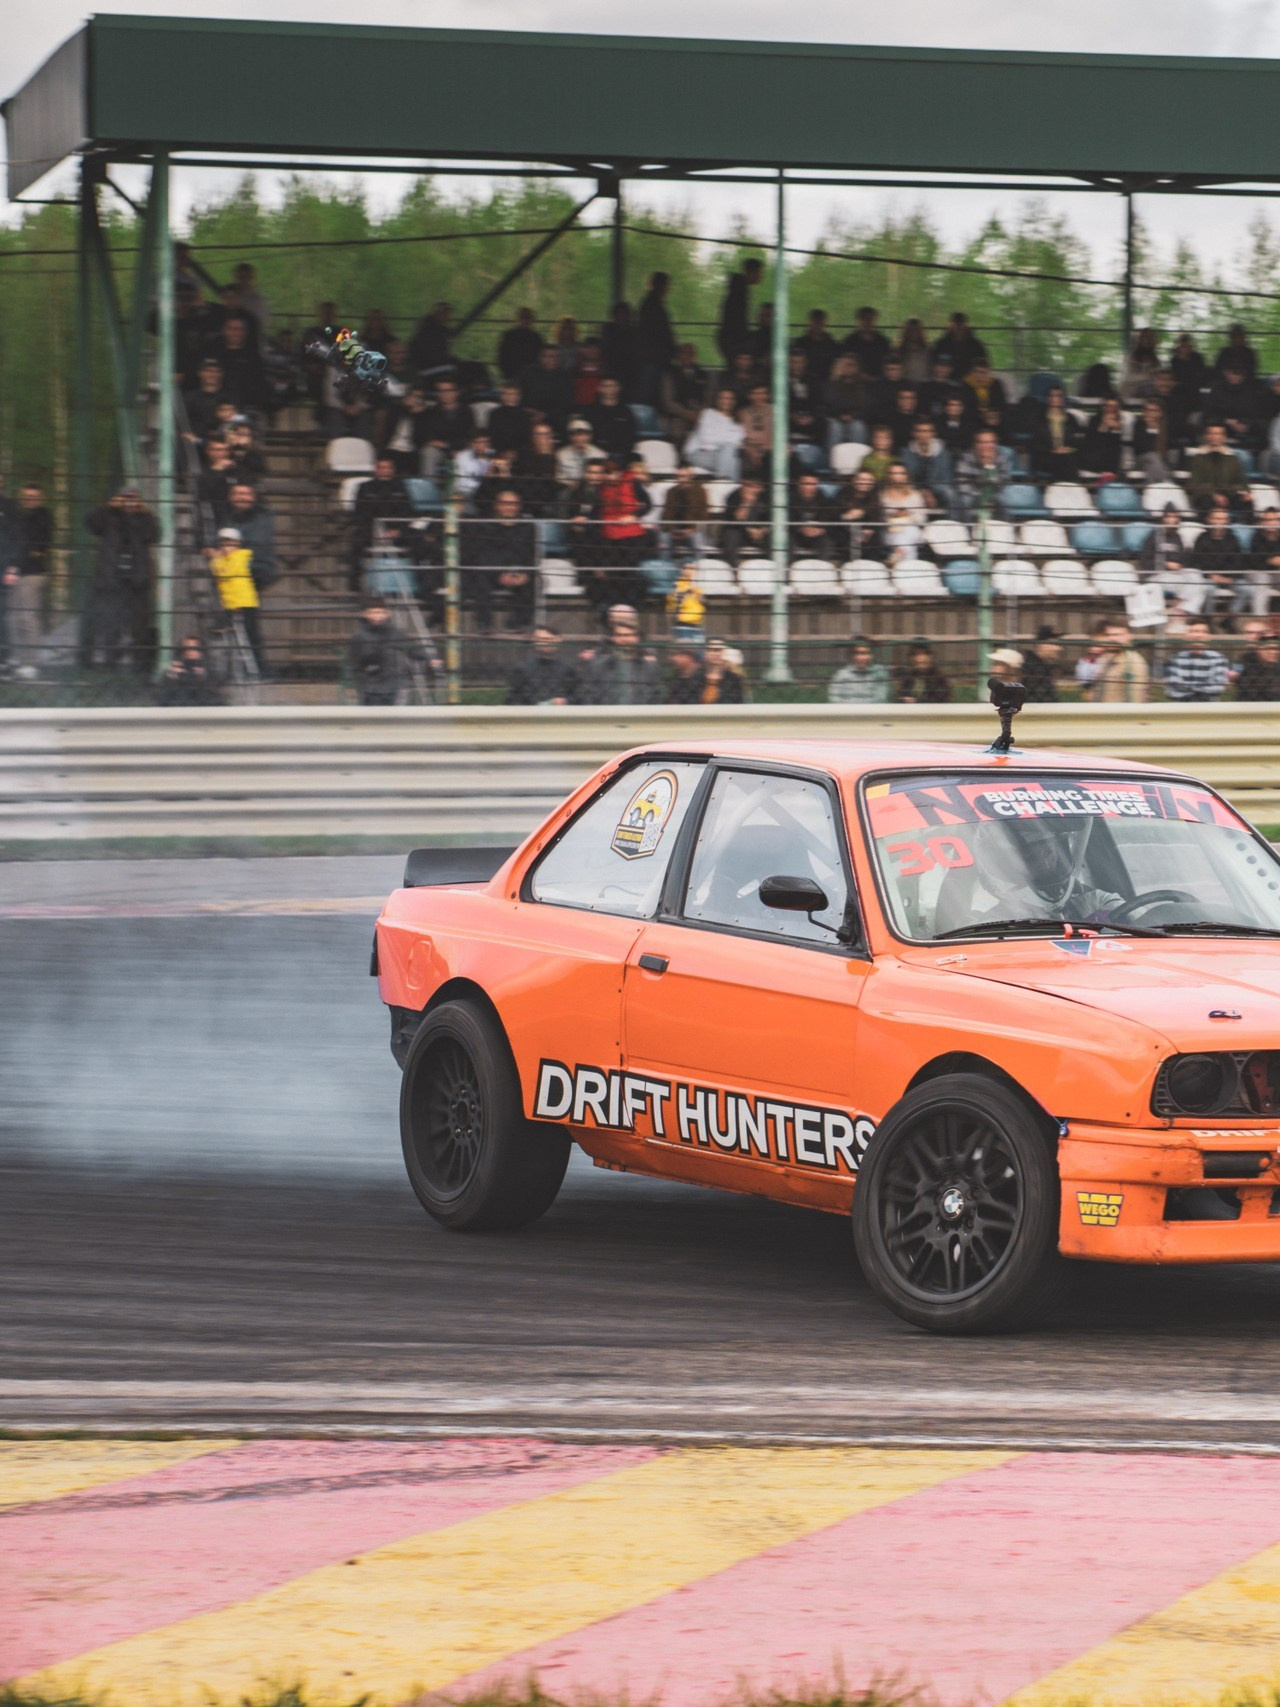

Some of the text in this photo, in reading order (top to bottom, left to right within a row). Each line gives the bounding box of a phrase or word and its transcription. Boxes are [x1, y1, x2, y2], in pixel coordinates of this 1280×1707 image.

[981, 789, 1145, 803] BURNING TIRES
[992, 801, 1157, 817] CHALLENGE
[885, 836, 975, 877] 30
[535, 1062, 670, 1137] DRIFT
[1078, 1202, 1120, 1217] WEGO
